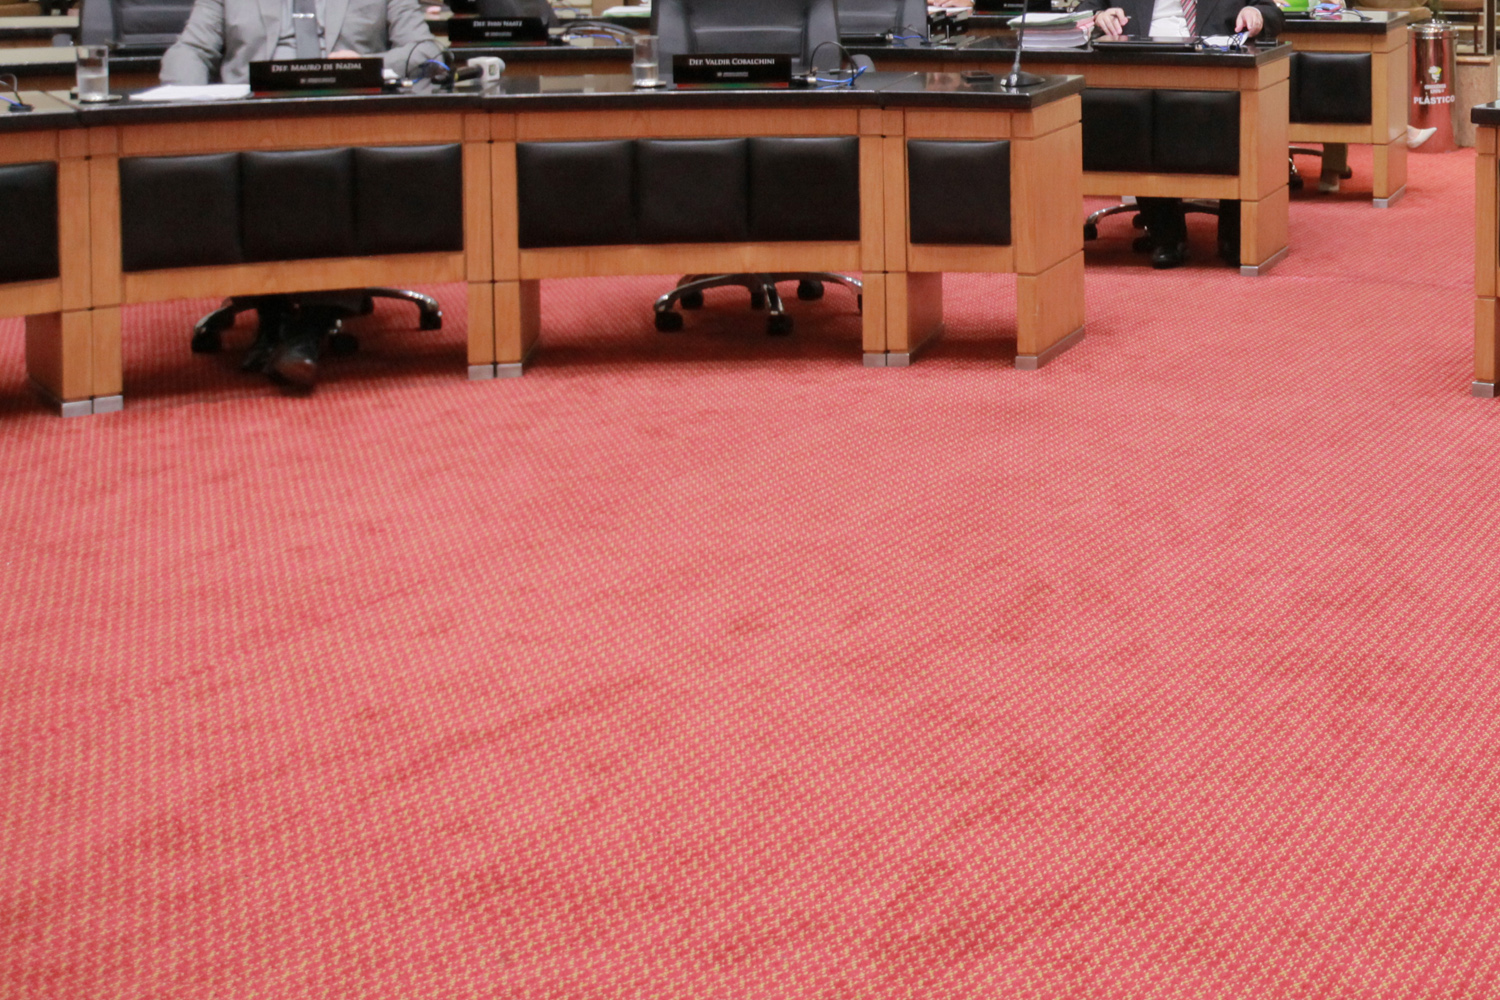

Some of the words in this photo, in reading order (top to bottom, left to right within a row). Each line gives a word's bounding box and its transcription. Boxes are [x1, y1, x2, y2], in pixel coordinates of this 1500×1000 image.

[705, 58, 731, 66] VALDIR
[731, 58, 775, 66] COBALCHINI
[290, 63, 321, 72] MAURO
[323, 63, 333, 71] DE
[335, 62, 362, 70] NADAL
